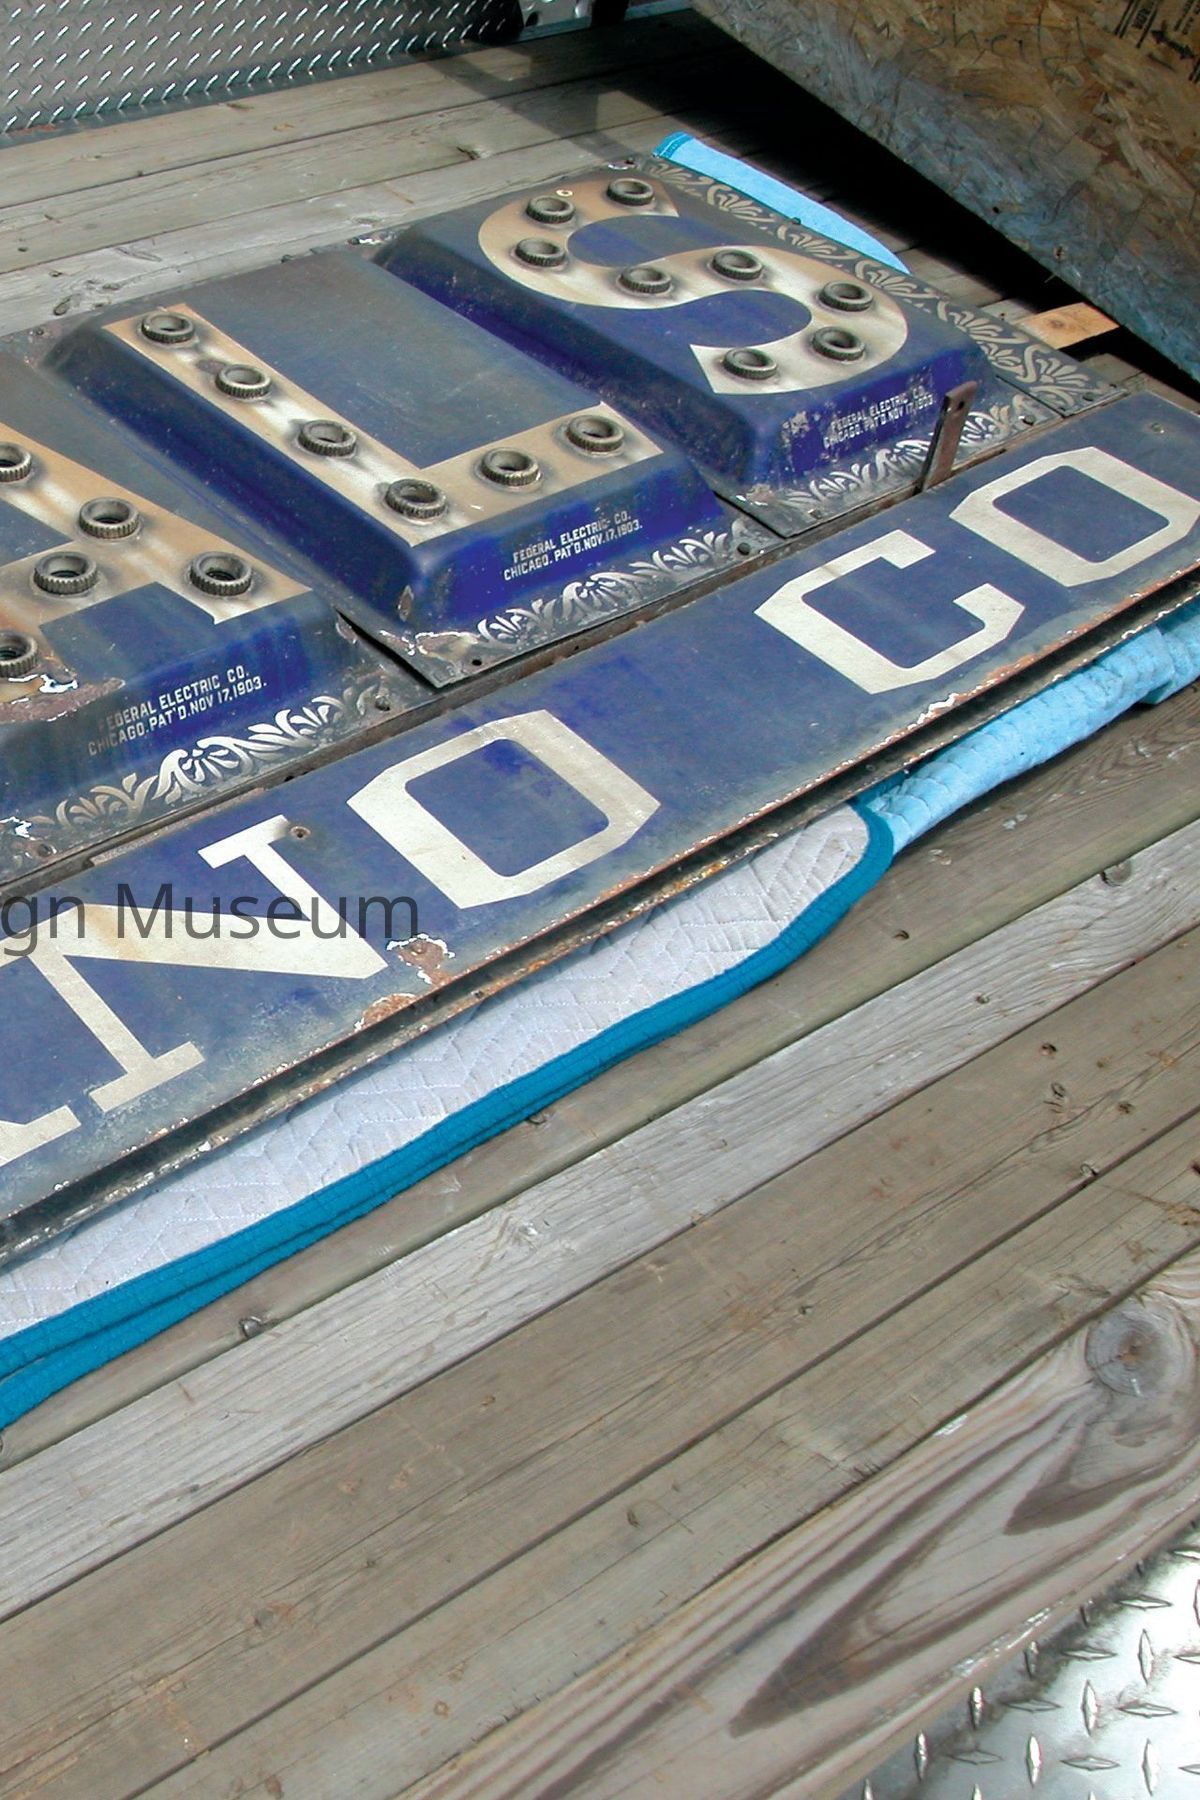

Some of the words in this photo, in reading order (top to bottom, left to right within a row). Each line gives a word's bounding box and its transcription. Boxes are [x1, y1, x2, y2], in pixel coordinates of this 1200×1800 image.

[830, 411, 867, 432] FEDERAL
[869, 394, 910, 418] ELECTRIC
[512, 539, 557, 564] FEDERAL
[560, 519, 609, 546] ELECTRIC
[613, 510, 632, 526] CO.
[755, 445, 1200, 694] CO
[158, 674, 221, 710] ELECTRIC
[226, 664, 250, 684] CO.
